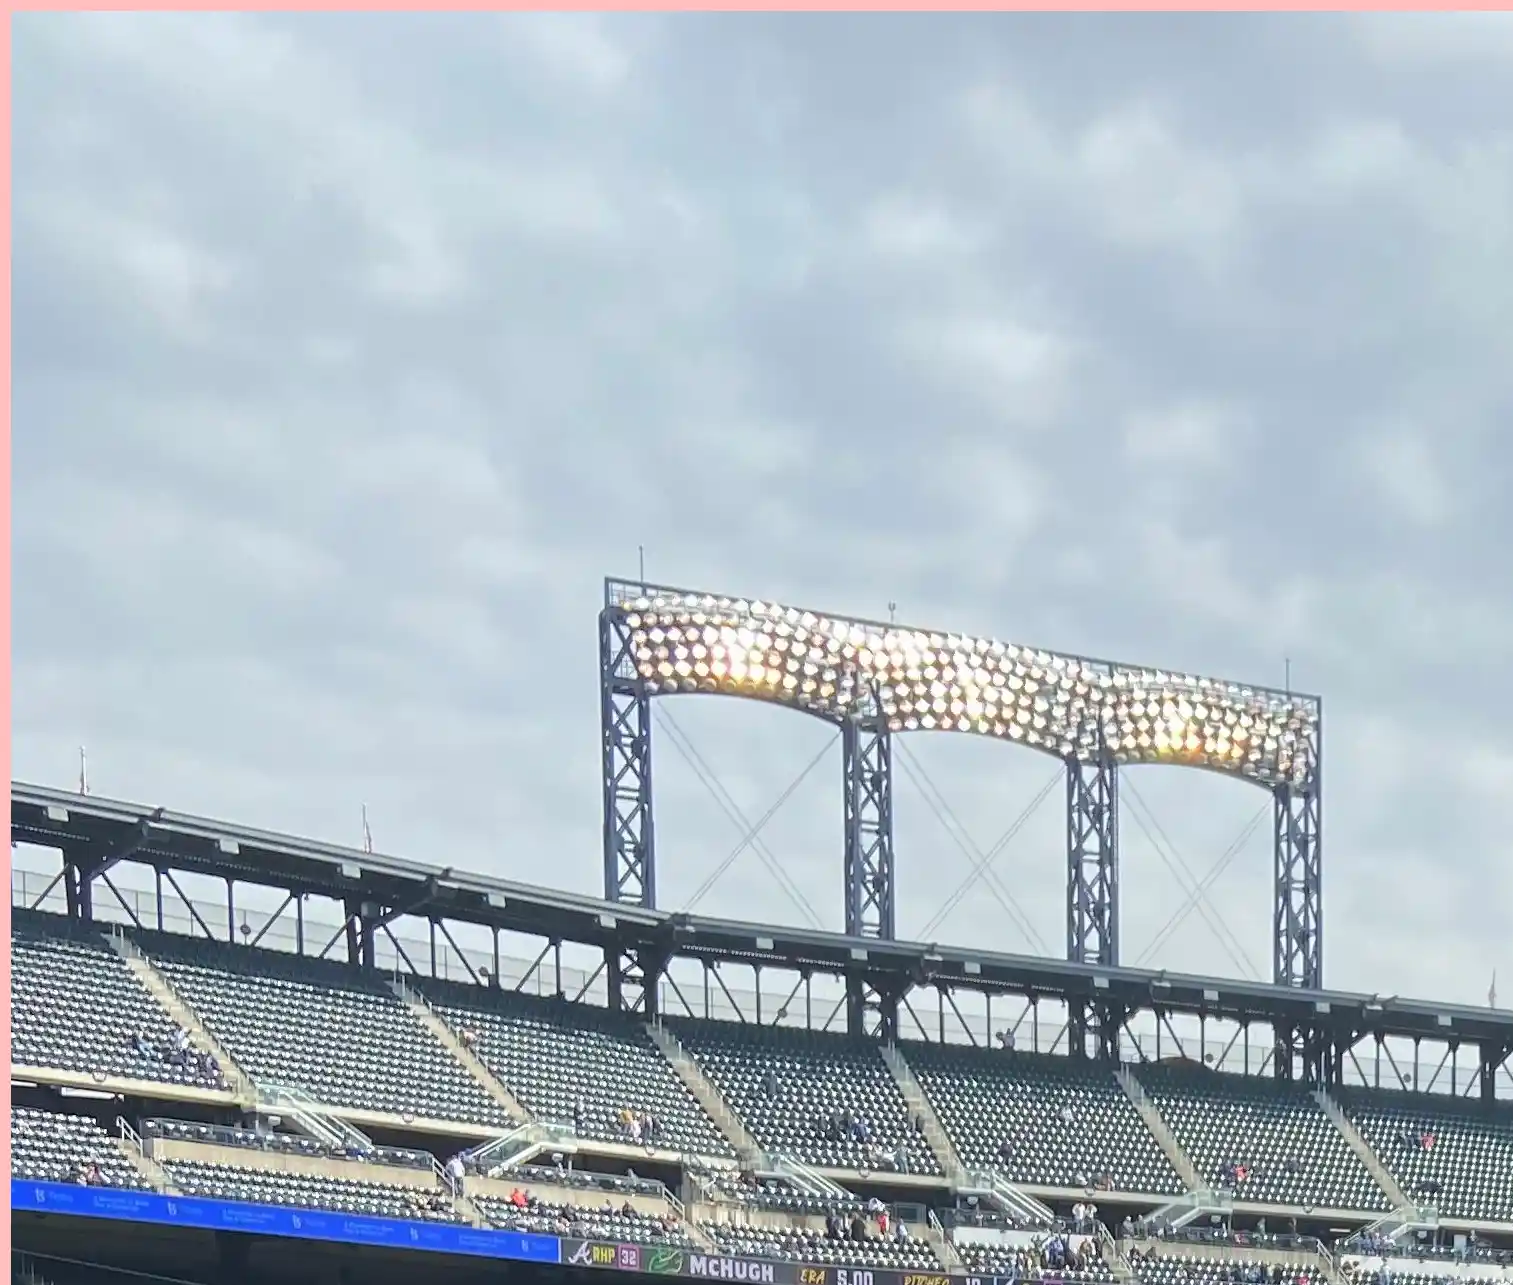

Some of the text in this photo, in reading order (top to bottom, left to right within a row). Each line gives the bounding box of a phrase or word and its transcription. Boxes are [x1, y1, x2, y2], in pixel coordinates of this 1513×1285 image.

[592, 1246, 615, 1264] RHP
[621, 1249, 637, 1265] 32
[689, 1254, 775, 1282] McHUGH
[800, 1268, 826, 1285] ERA
